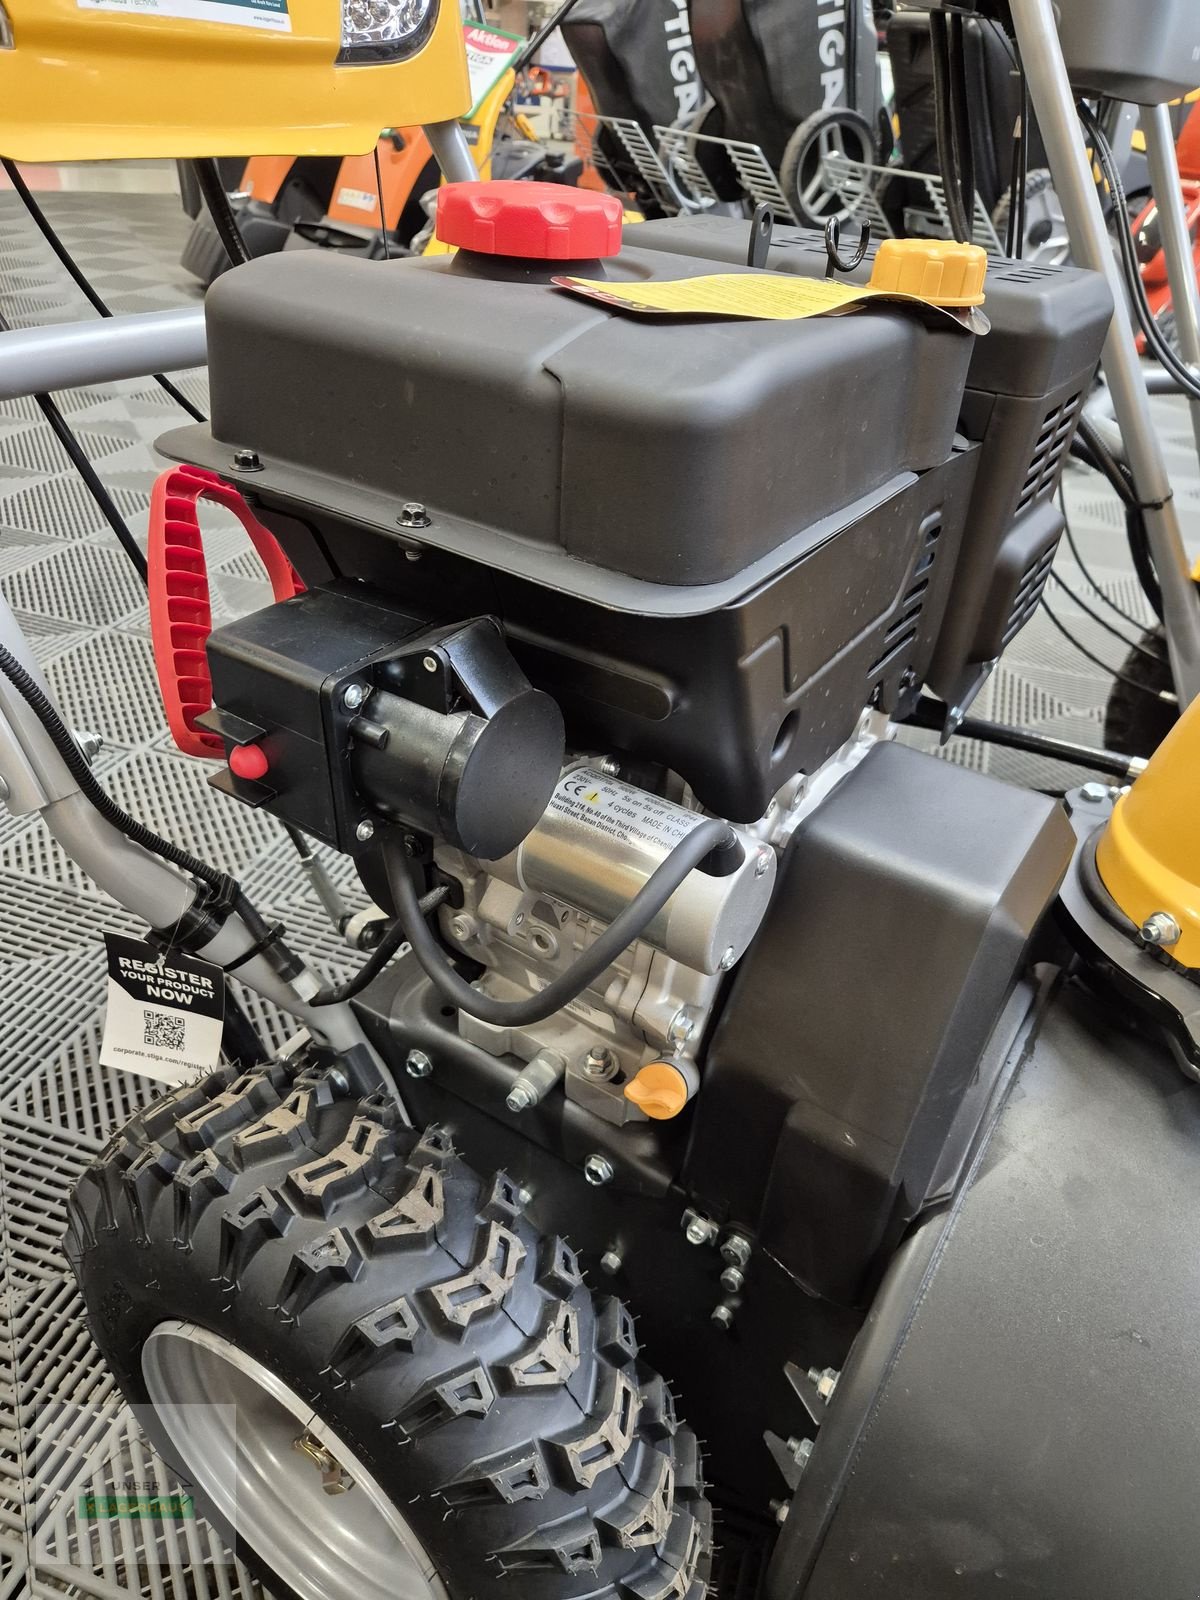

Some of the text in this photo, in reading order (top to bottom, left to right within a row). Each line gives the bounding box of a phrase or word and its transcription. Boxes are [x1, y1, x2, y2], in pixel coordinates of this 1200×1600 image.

[467, 28, 511, 50] Aktion
[554, 792, 576, 808] Building
[607, 815, 616, 825] the
[614, 818, 631, 832] Third
[629, 825, 647, 839] Village
[613, 804, 638, 819] cycles
[641, 815, 664, 830] MADE
[663, 825, 672, 834] IN
[671, 829, 687, 840] CHI
[632, 800, 643, 808] on
[653, 808, 666, 817] off
[118, 957, 213, 989] REGISTER
[120, 969, 215, 999] YOUR PRODUCT
[146, 984, 193, 1005] NOW
